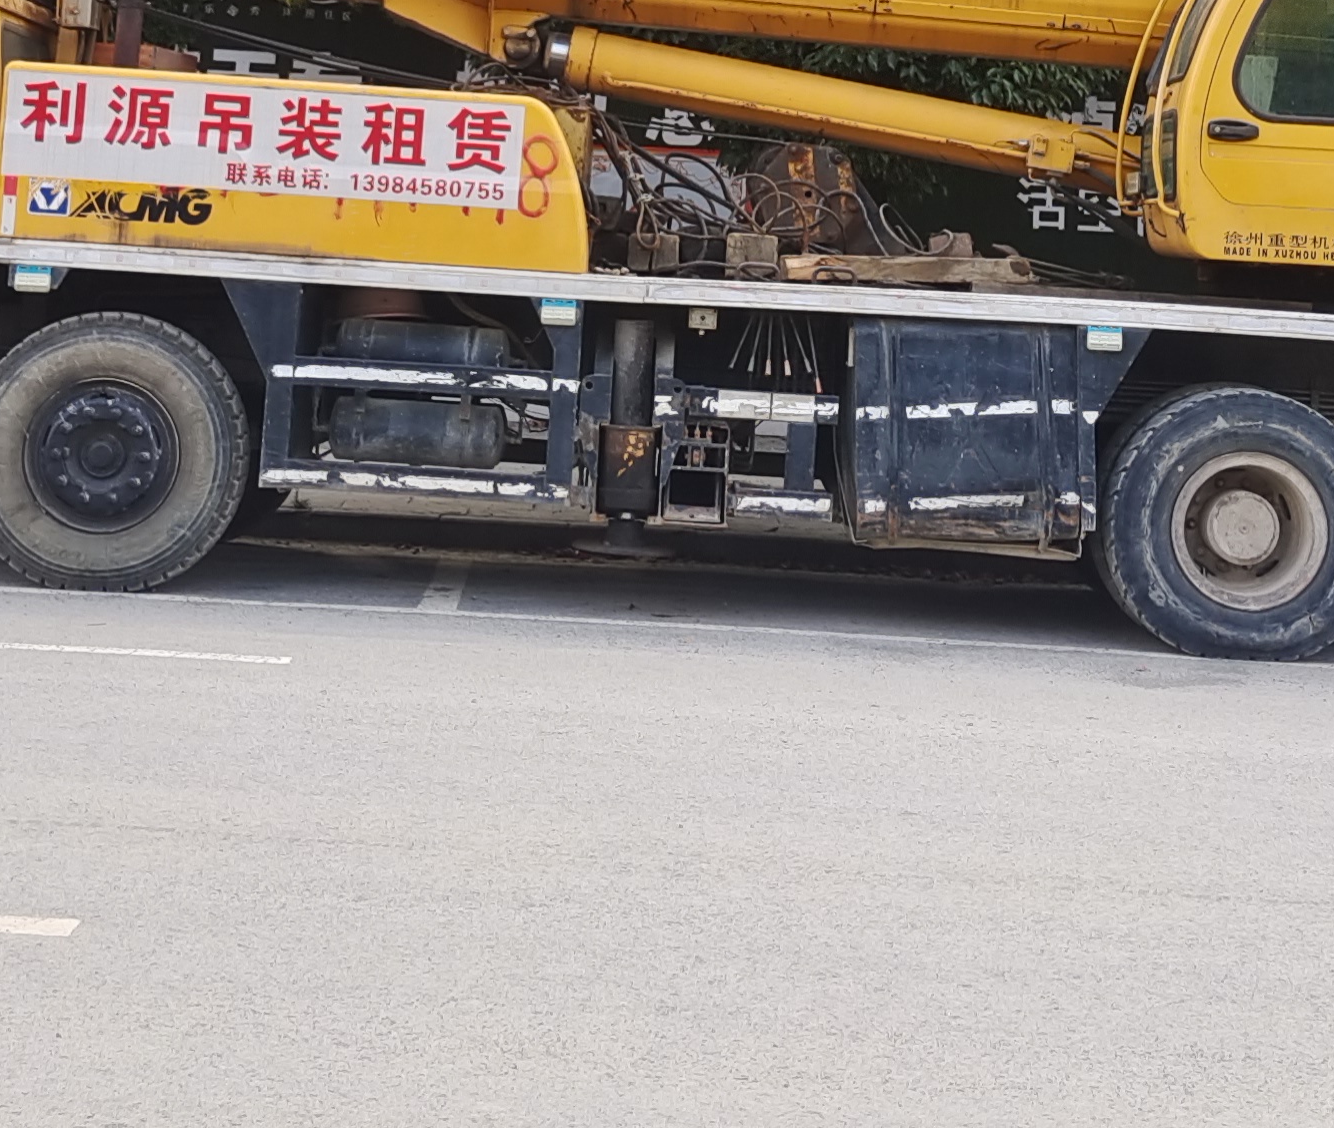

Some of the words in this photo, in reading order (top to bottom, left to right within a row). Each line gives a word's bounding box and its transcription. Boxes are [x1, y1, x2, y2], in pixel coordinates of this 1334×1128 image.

[20, 79, 512, 174] 利源吊装租赁
[350, 173, 505, 202] 13984580755
[1223, 246, 1252, 257] MADE
[1258, 248, 1268, 258] IN
[1273, 249, 1317, 260] XUZHOU
